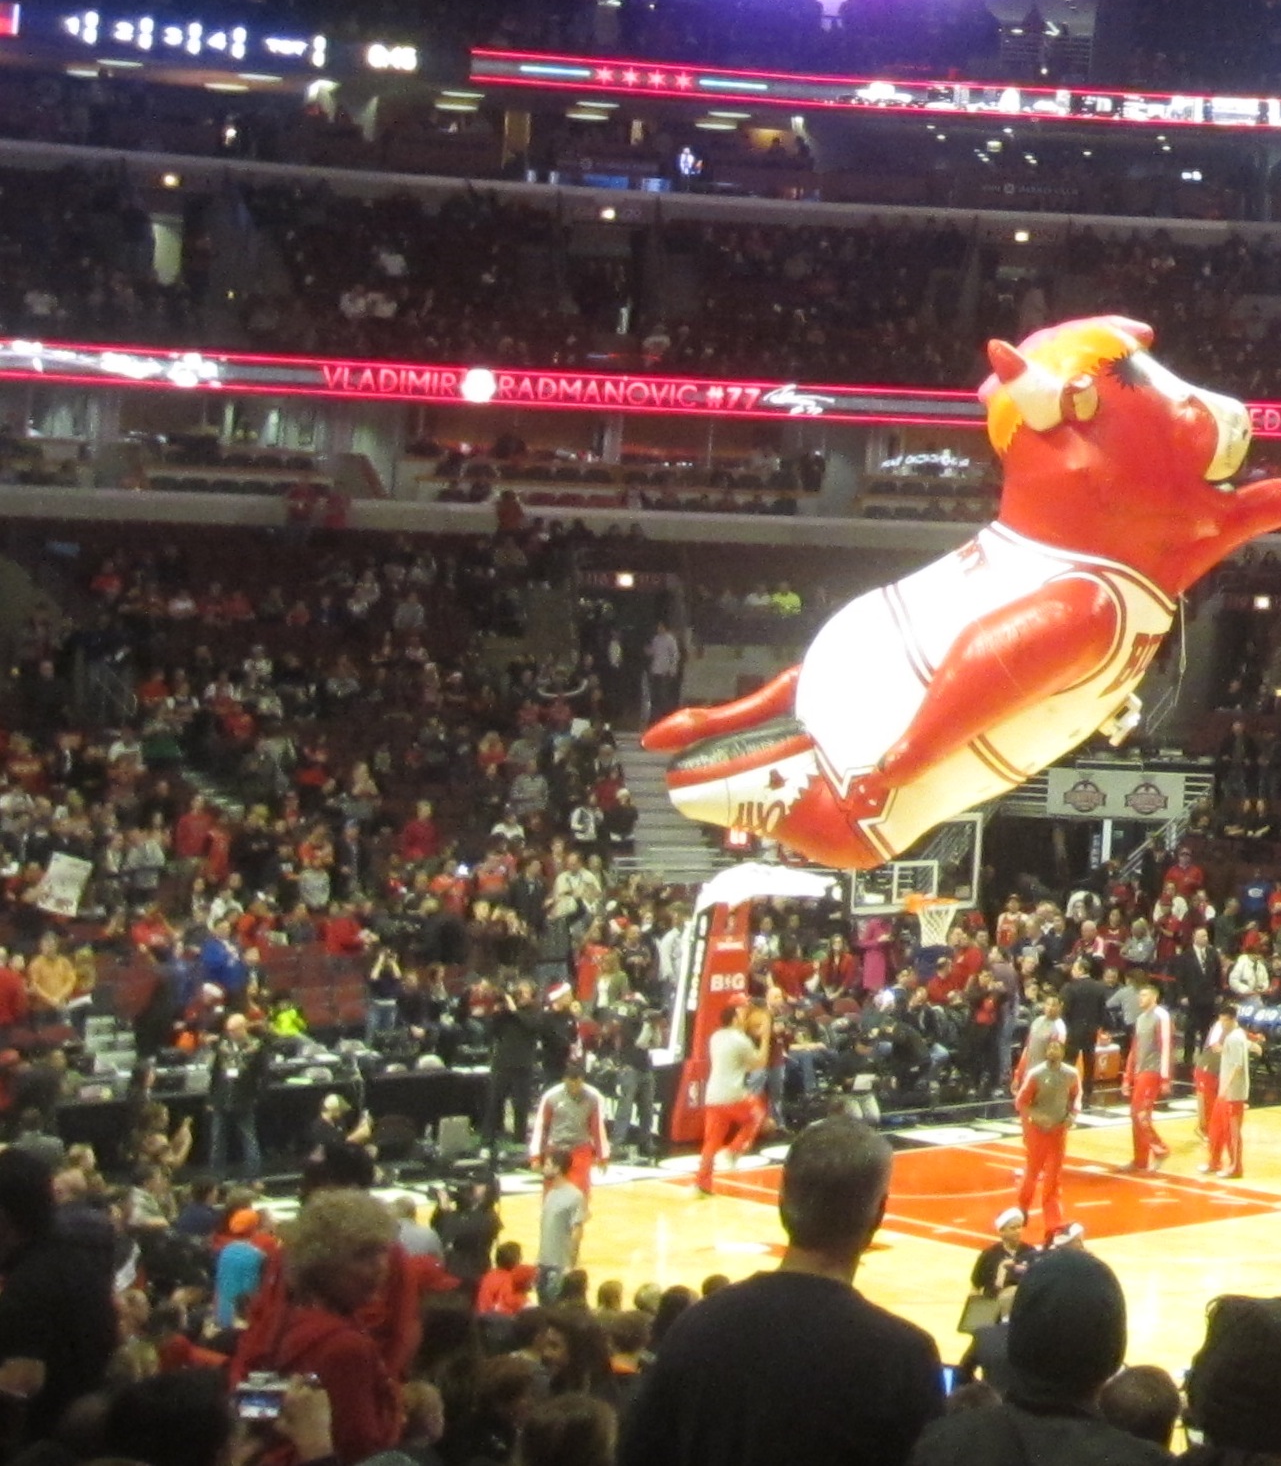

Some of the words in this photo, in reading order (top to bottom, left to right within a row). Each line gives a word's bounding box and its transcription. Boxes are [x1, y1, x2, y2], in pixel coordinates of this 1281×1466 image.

[322, 363, 457, 398] VLADIMIR
[500, 375, 697, 410] RADMANOVIC
[706, 386, 761, 411] #77
[709, 972, 746, 993] BIG
